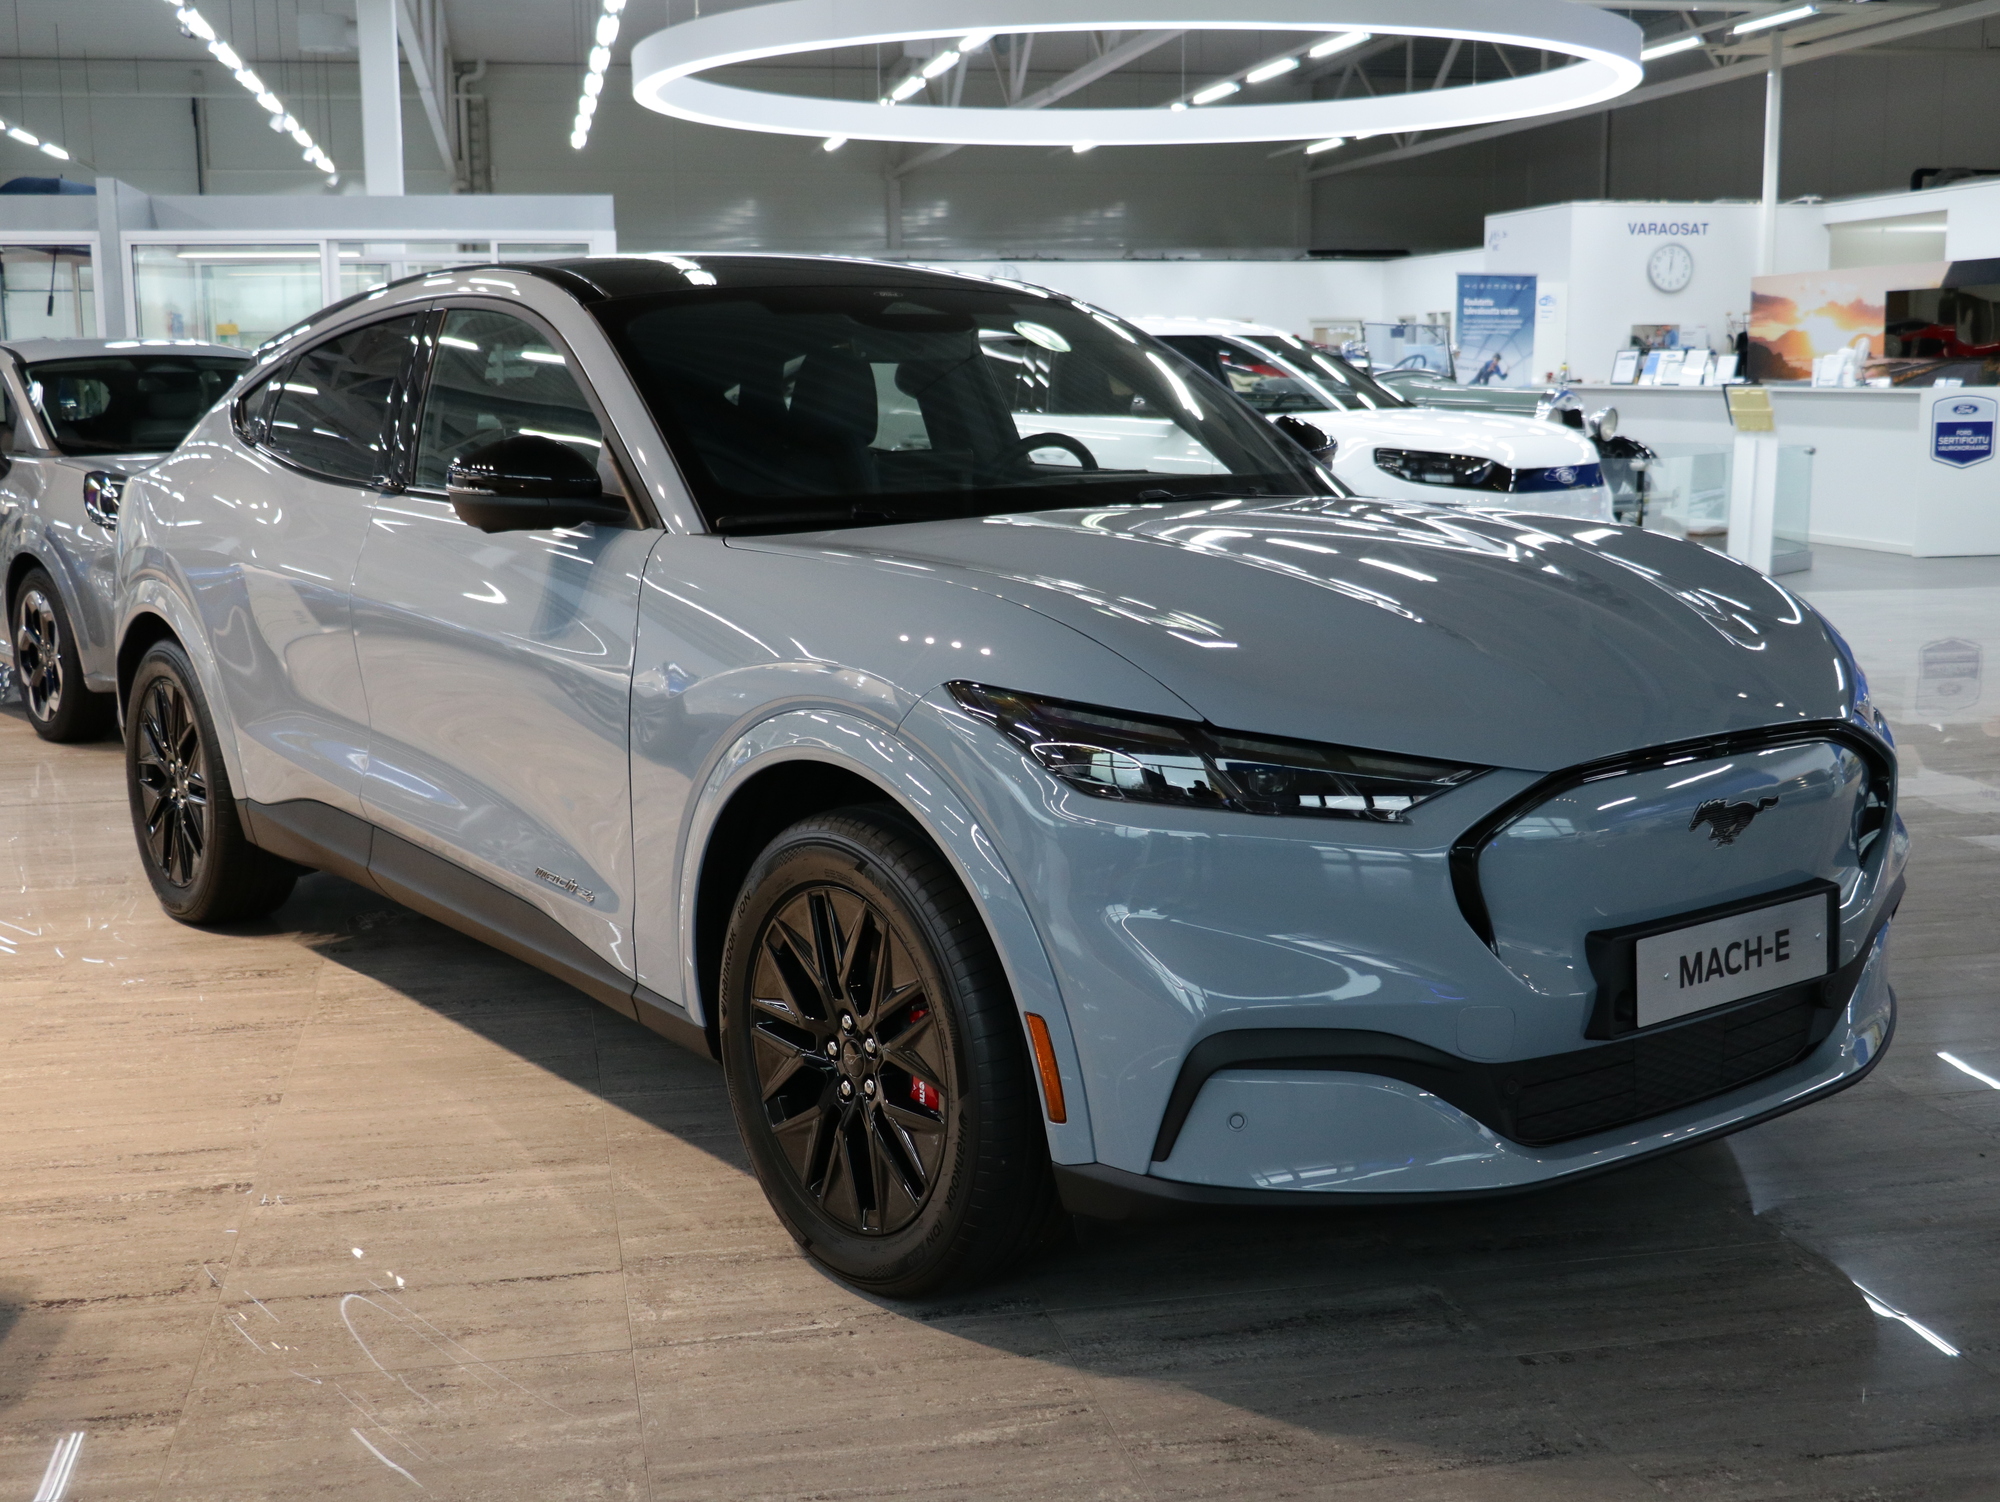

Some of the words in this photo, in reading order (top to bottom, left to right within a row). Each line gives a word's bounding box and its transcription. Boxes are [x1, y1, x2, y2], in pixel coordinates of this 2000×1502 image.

[1628, 222, 1709, 236] VARAOSAT
[1938, 436, 1989, 445] SERTIFIOITU
[1679, 928, 1790, 989] MACH-E
